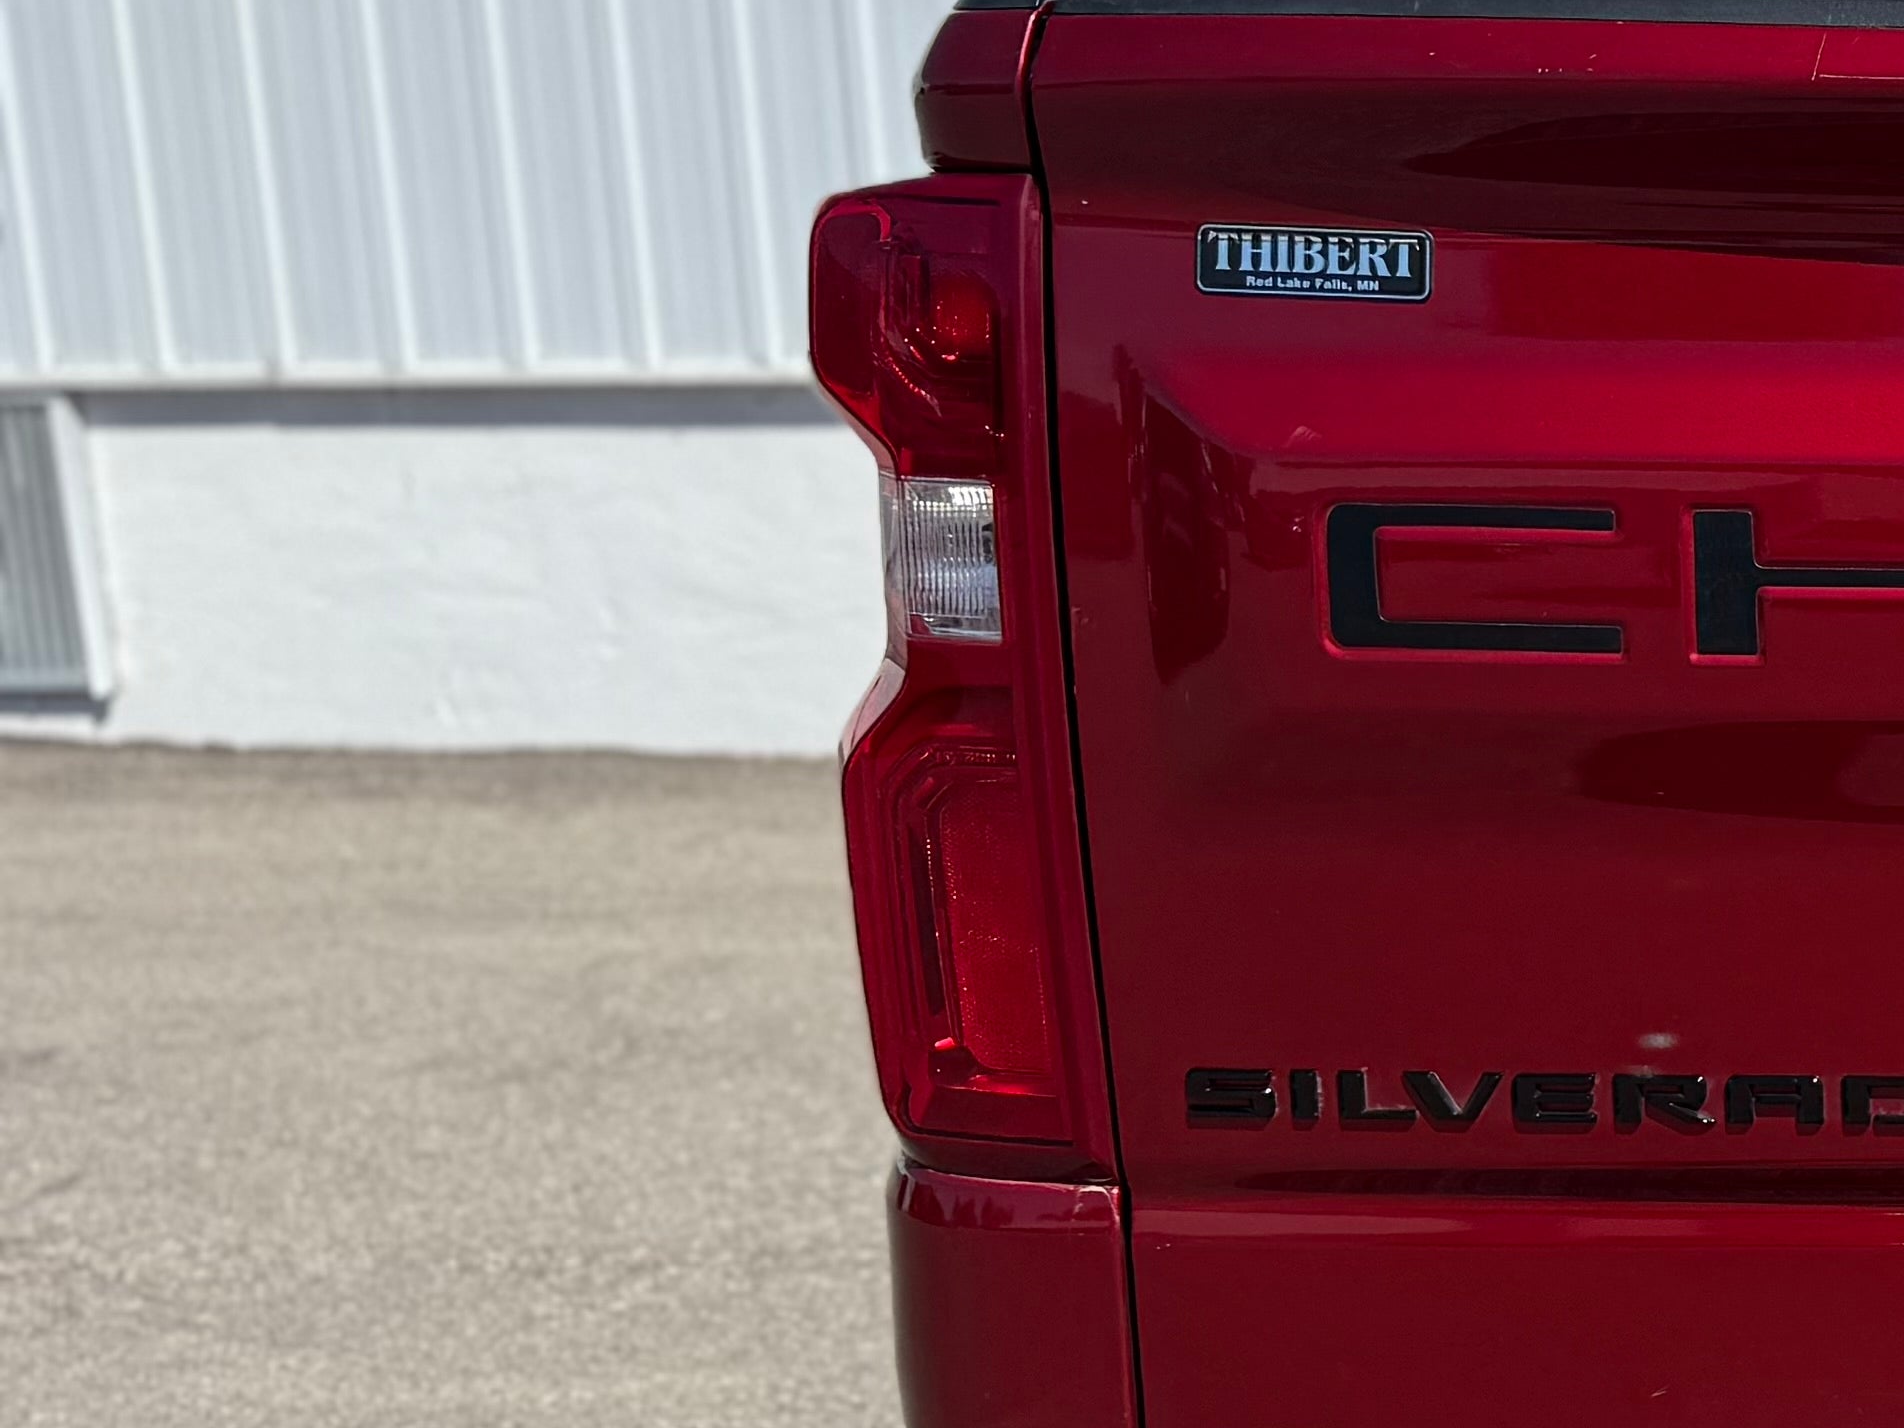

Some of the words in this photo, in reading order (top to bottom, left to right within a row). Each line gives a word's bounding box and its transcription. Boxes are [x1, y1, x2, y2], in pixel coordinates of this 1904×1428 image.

[1207, 230, 1420, 278] THIBERT
[1245, 276, 1273, 288] Red
[1277, 277, 1310, 289] Lake
[1315, 278, 1353, 292] Falls,
[1357, 280, 1380, 292] MN
